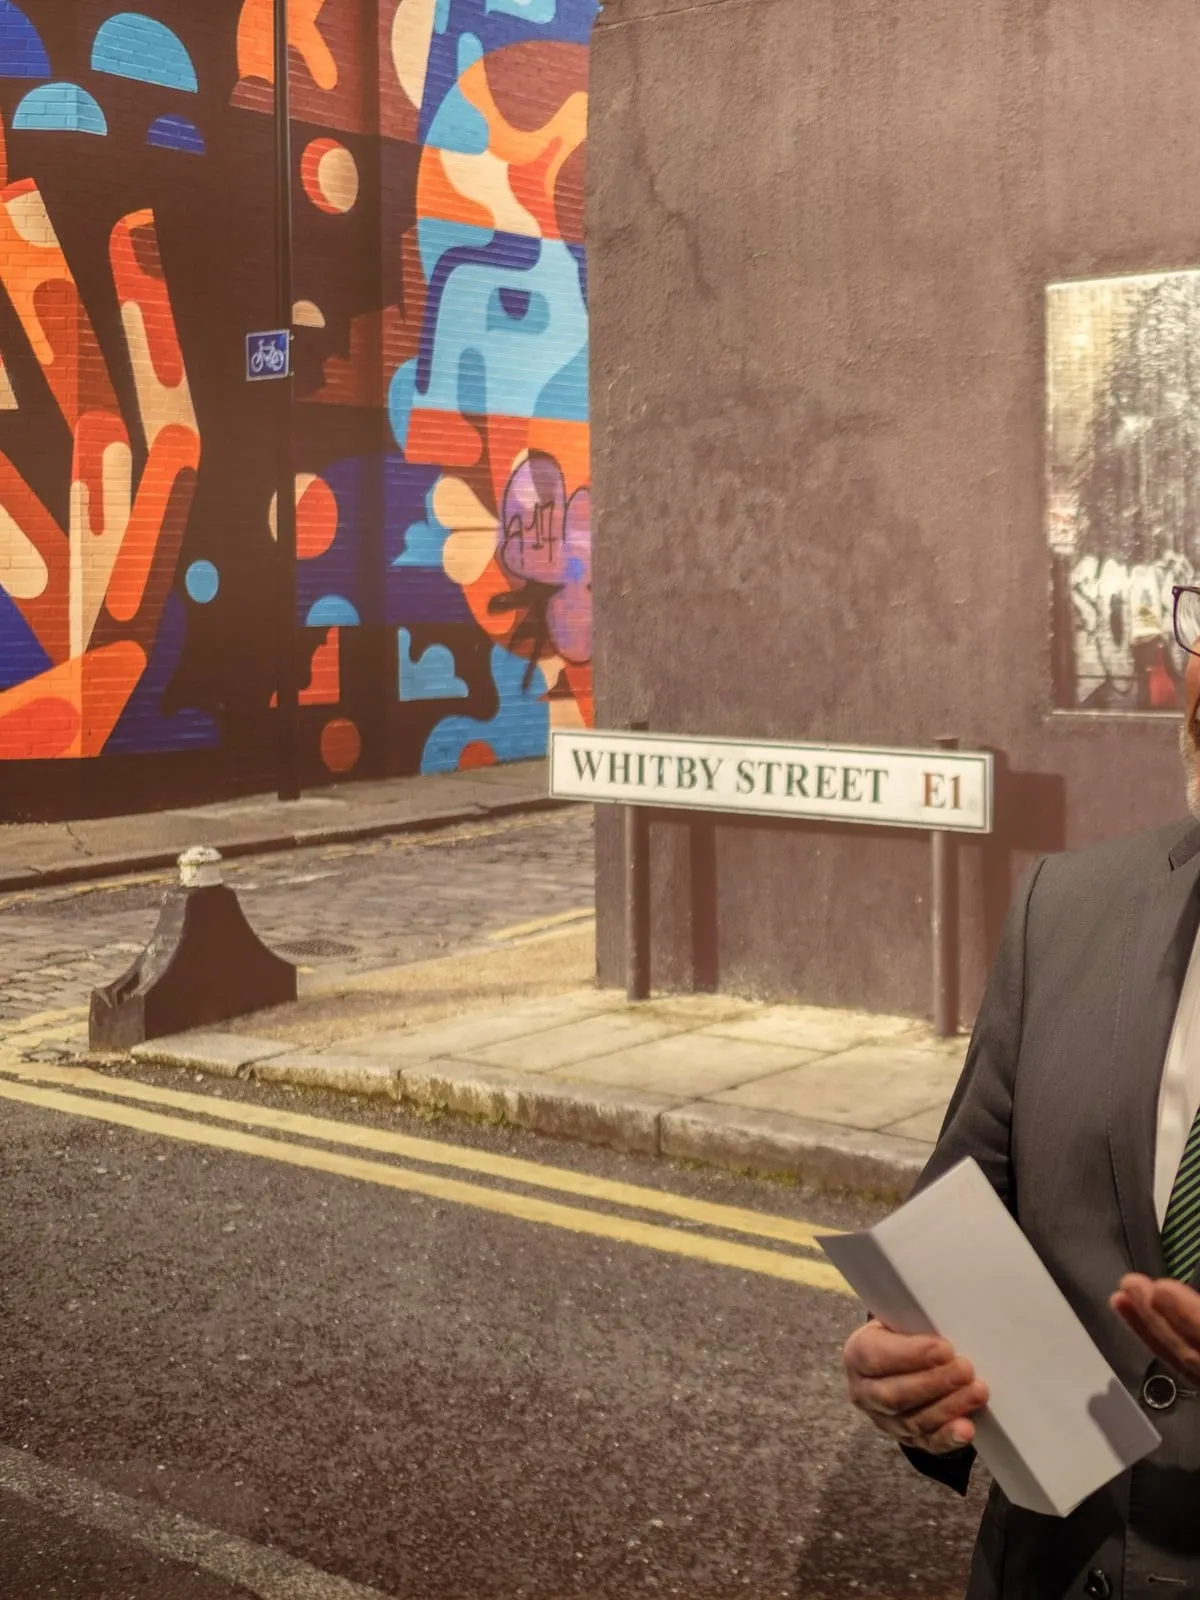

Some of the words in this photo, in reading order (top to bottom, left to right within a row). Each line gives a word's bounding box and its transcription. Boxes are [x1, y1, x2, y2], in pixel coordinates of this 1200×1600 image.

[572, 748, 724, 792] WHITBY
[736, 759, 890, 804] STREET
[922, 771, 963, 810] E1
